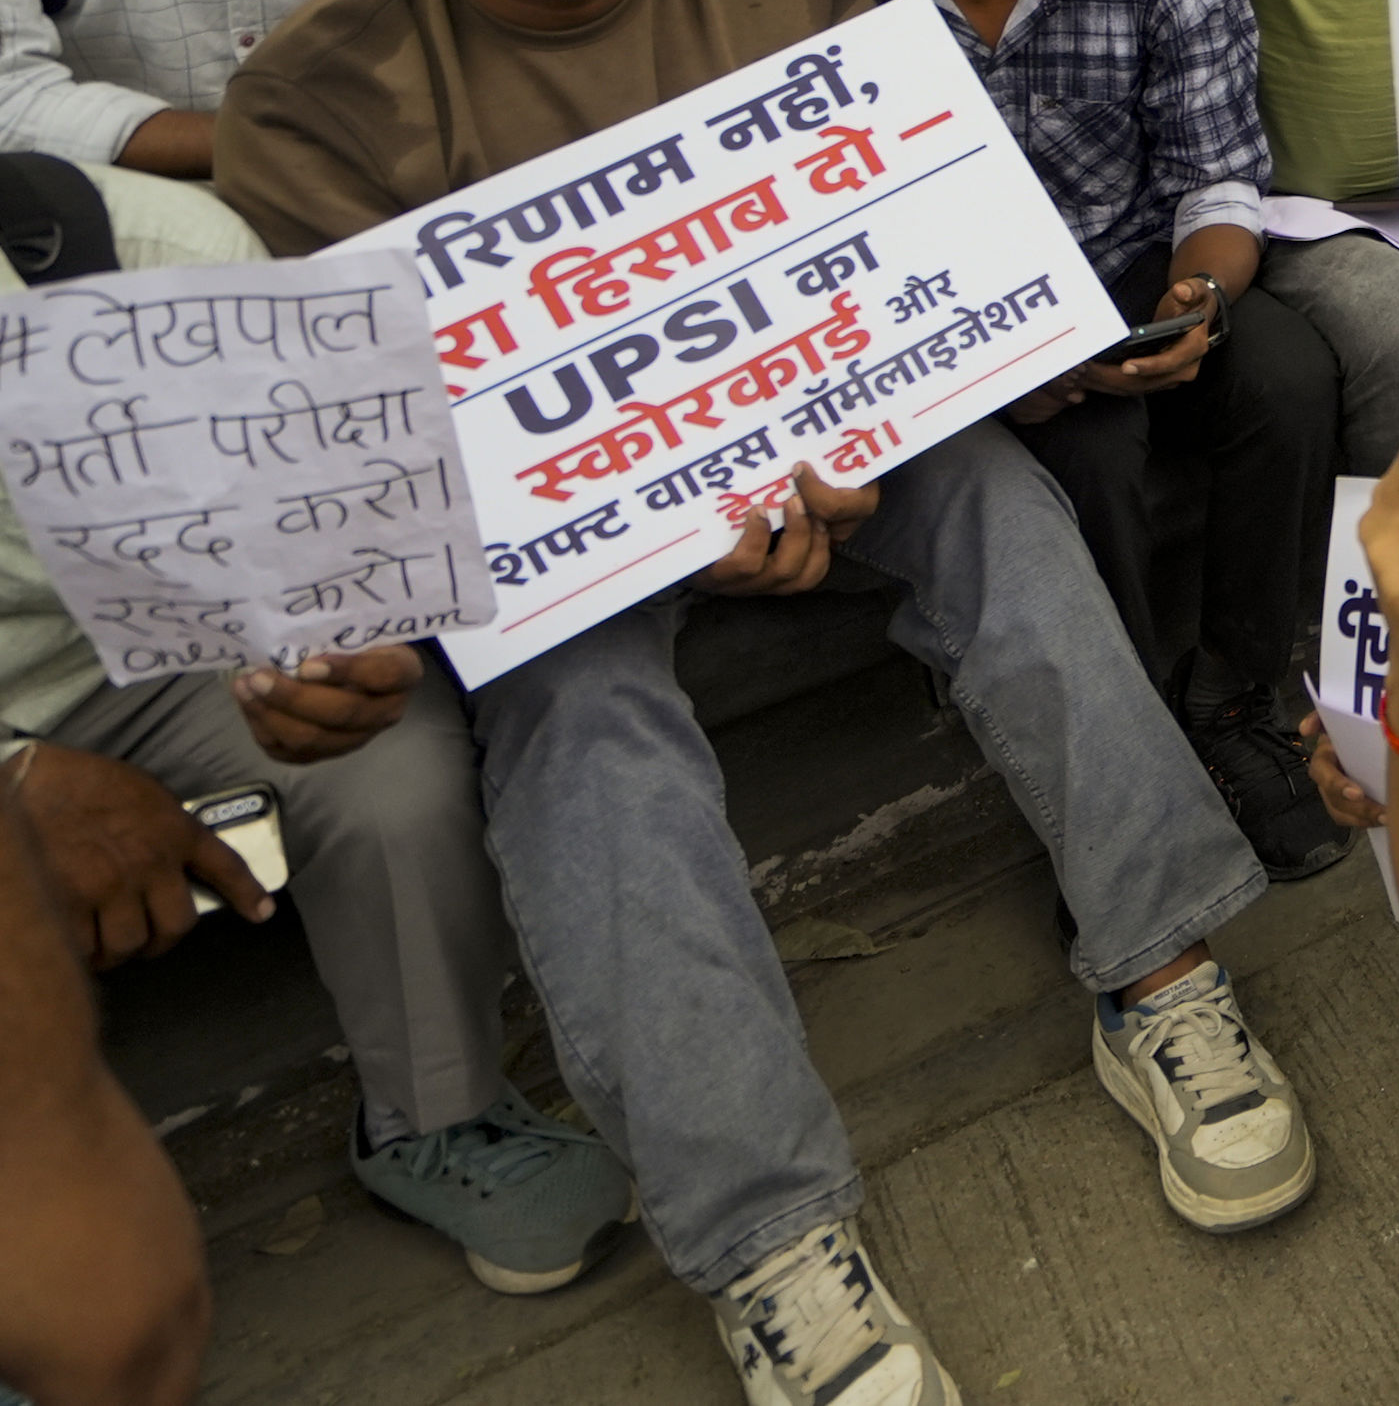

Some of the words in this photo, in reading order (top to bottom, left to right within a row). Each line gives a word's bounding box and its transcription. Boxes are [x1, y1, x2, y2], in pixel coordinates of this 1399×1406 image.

[527, 176, 791, 335] हिसाब
[795, 127, 888, 194] दो
[10, 394, 198, 497] भर्ती
[210, 379, 424, 470] परीक्षा
[503, 279, 773, 439] UPSI
[784, 233, 882, 305] का
[515, 291, 873, 504] स्कोरकार्ड
[885, 270, 961, 326] और
